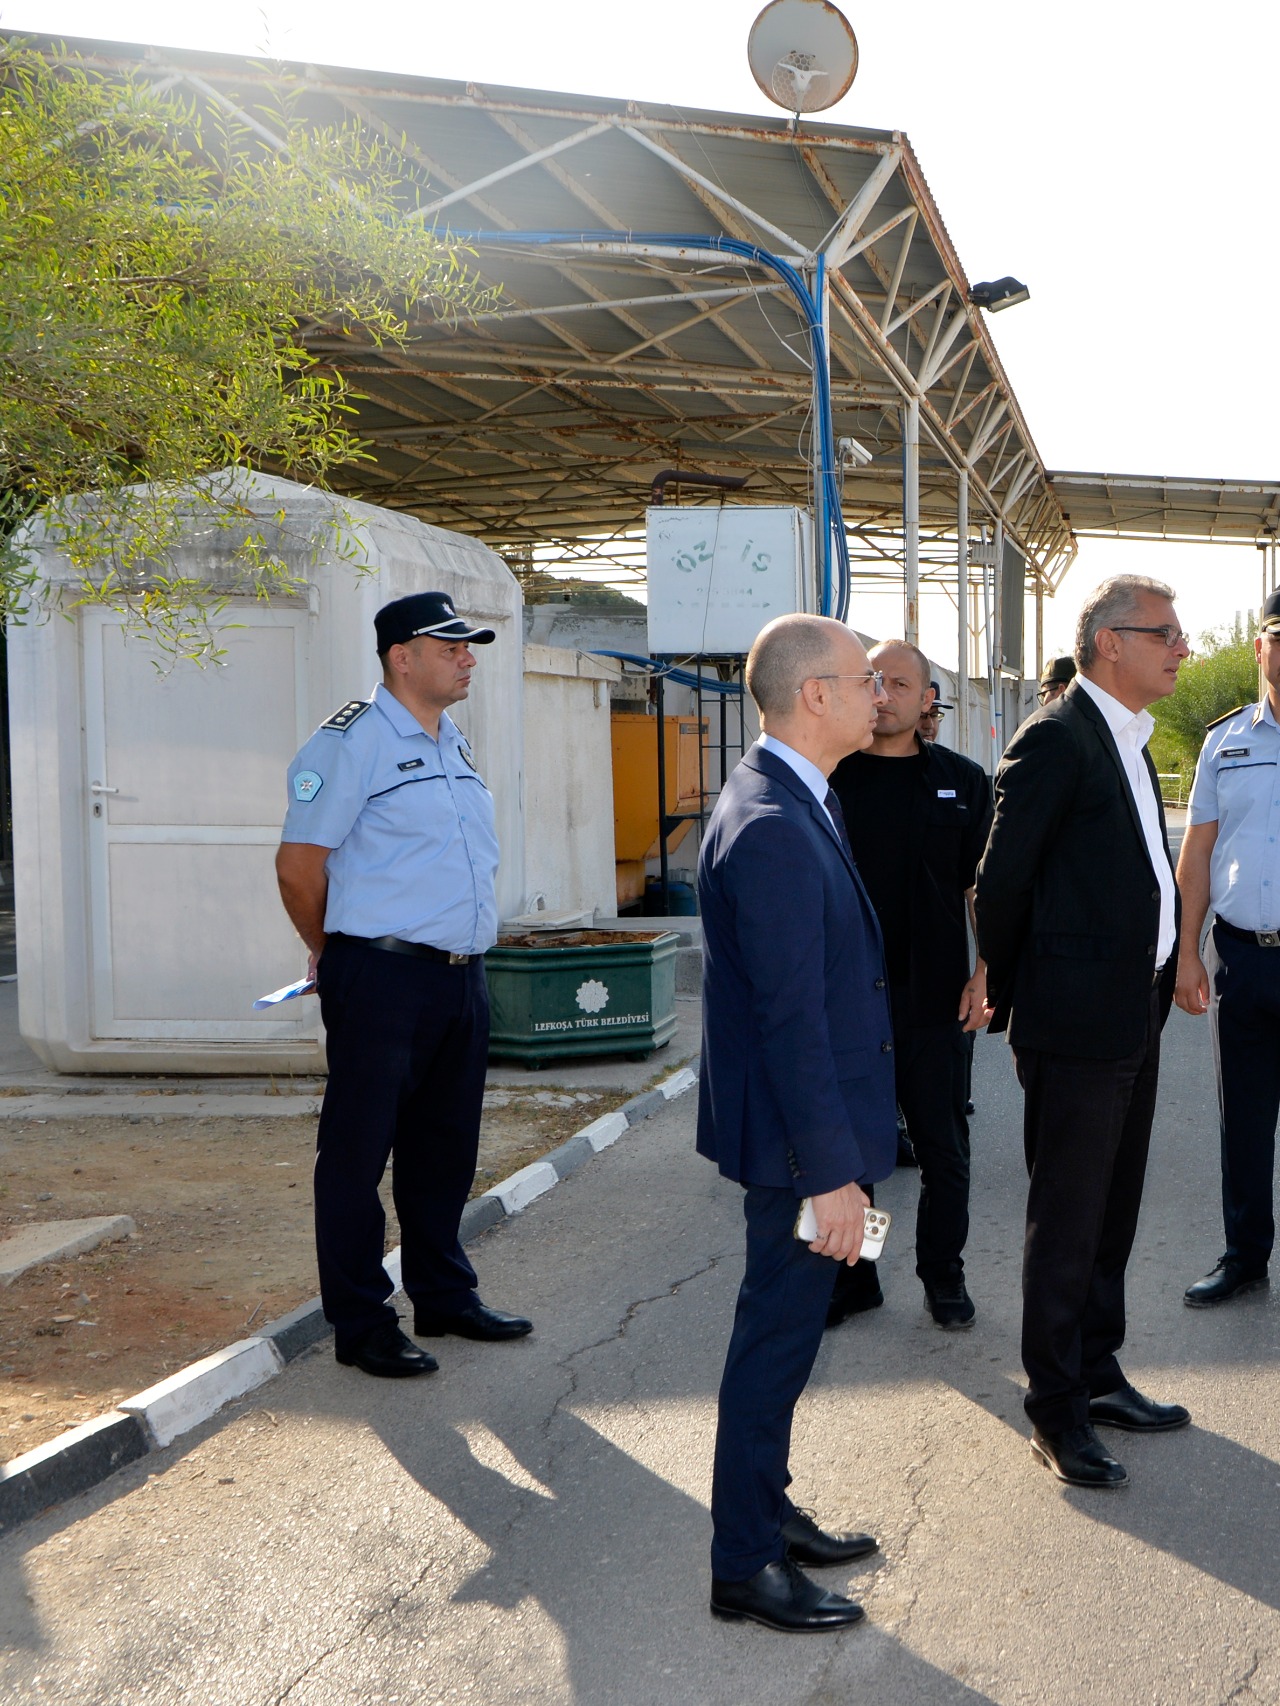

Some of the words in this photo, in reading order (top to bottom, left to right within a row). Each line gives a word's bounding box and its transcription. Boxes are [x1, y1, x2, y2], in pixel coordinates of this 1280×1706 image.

[534, 1020, 574, 1032] LEFKOŞA
[574, 1017, 599, 1028] TÜRK
[601, 1011, 650, 1027] BELEDİYESİ
